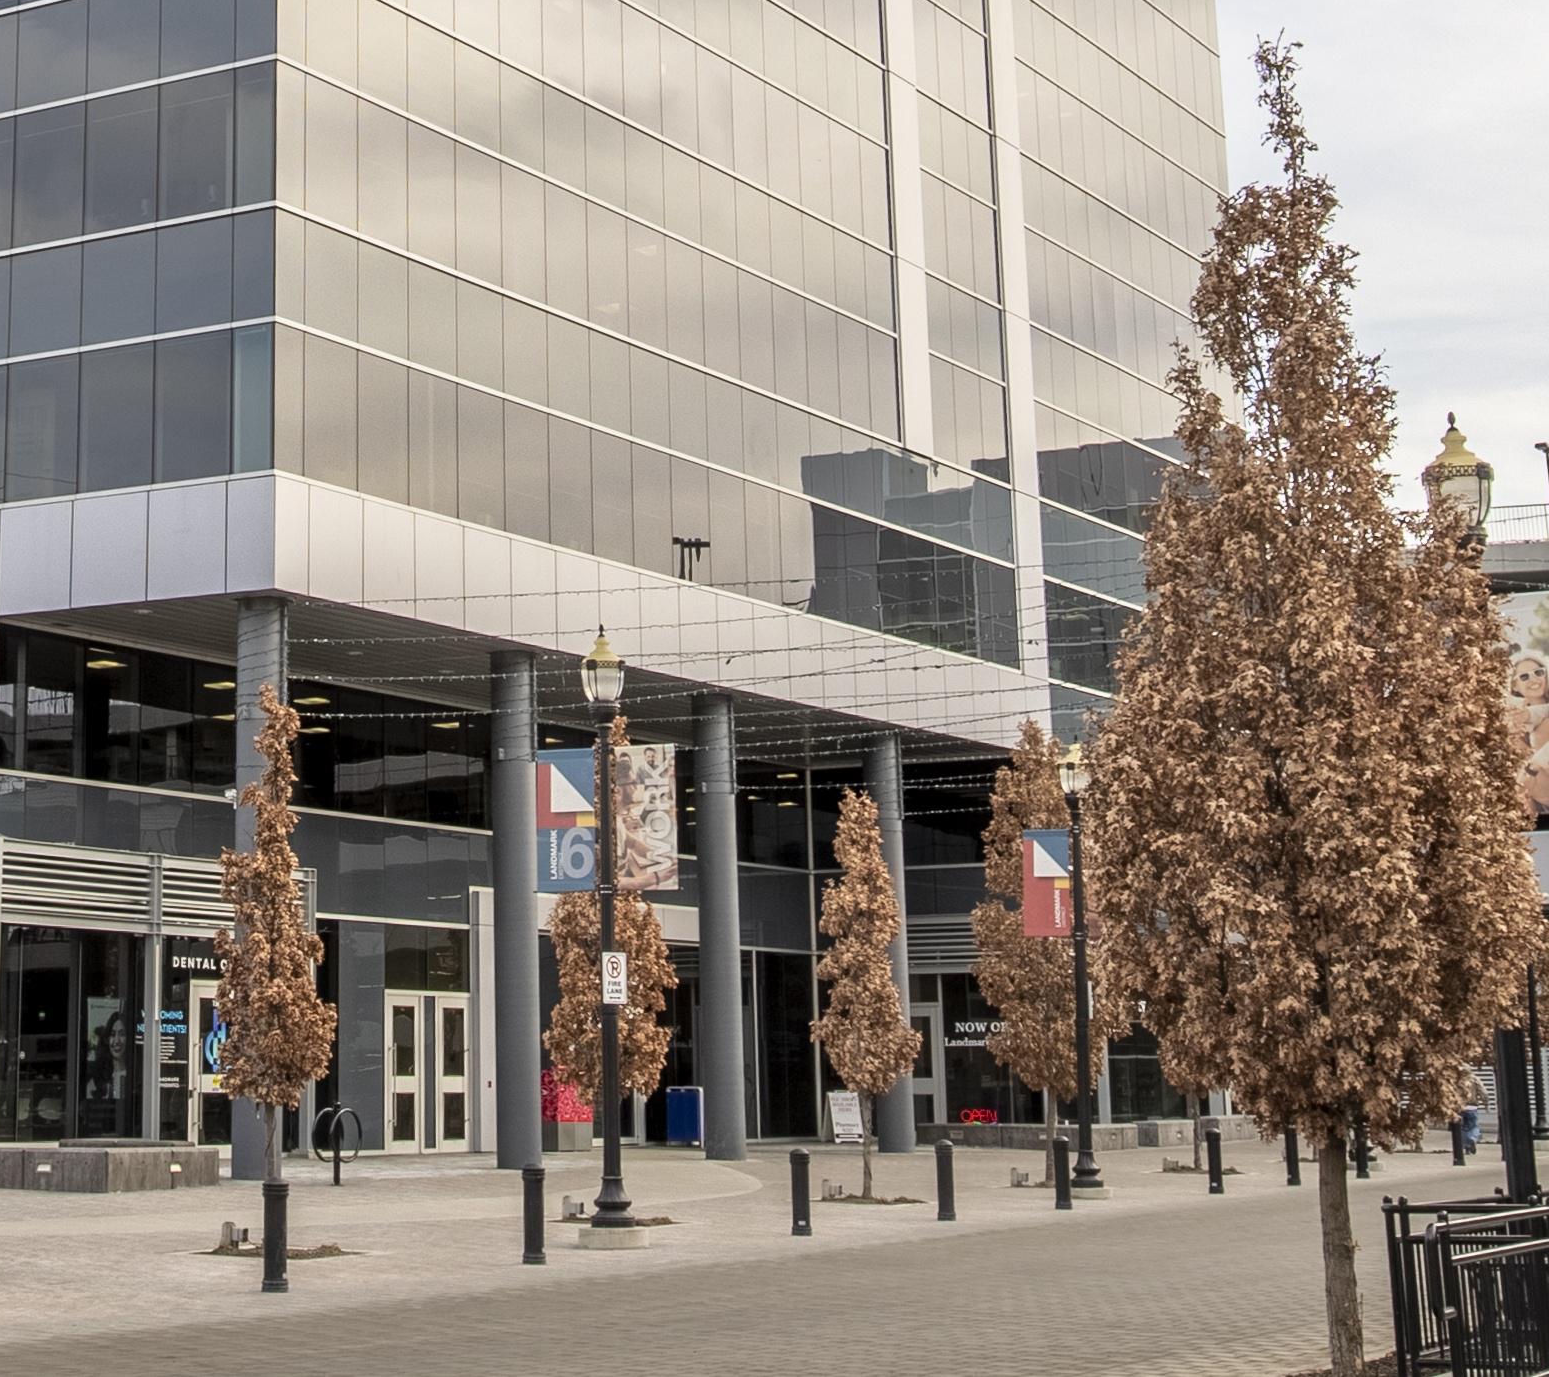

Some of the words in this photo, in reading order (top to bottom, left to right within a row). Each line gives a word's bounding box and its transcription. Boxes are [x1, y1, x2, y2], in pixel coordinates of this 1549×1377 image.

[644, 758, 672, 874] WORK
[550, 830, 558, 880] LANDMARK
[561, 827, 594, 879] 6
[172, 956, 217, 970] DENTAL
[955, 1022, 987, 1032] NOW
[961, 1109, 997, 1123] OPEN
